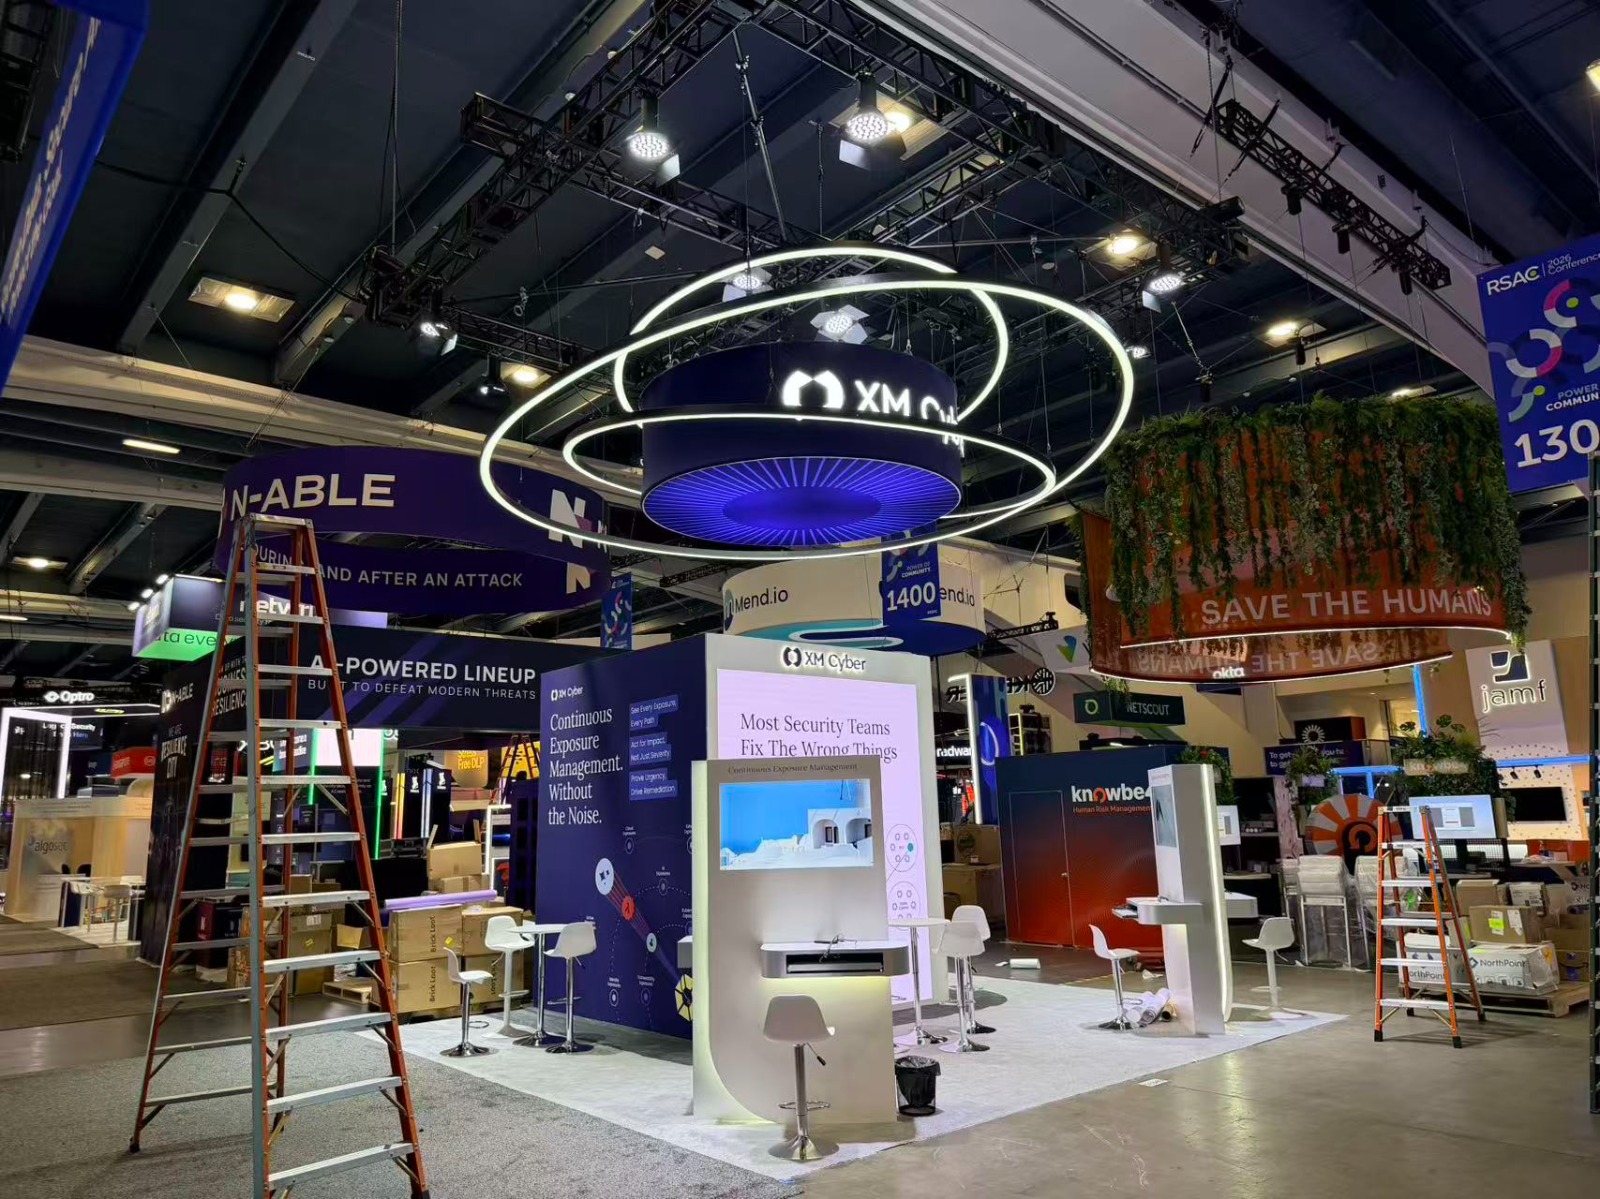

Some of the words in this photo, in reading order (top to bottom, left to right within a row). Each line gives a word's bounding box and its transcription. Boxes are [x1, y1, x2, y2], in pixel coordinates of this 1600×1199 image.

[1548, 254, 1571, 269] 2026
[1548, 252, 1600, 275] Conferenc
[1486, 266, 1540, 296] RSAC
[855, 380, 909, 417] XM
[1545, 392, 1600, 412] COMMUN
[1557, 383, 1599, 400] POWER
[1514, 419, 1600, 468] 130
[230, 474, 396, 521] N-ABLE
[319, 564, 352, 582] AND
[358, 571, 417, 586] AFTER
[424, 573, 449, 587] AN
[455, 573, 523, 588] ATTACK
[736, 586, 789, 613] Mend.io
[887, 582, 936, 612] 1400
[940, 586, 976, 607] end.io
[1201, 594, 1290, 625] SAVE
[1302, 591, 1371, 616] THE
[1383, 588, 1492, 616] HUMANS
[310, 655, 457, 682] A-POWERED
[464, 664, 536, 684] LINEUP
[804, 652, 824, 666] XM
[828, 654, 866, 671] Cyber
[1212, 667, 1245, 679] okta
[308, 679, 348, 692] BUT
[353, 681, 369, 693] TO
[375, 683, 424, 695] DEFEAT
[428, 685, 480, 698] MODERN
[484, 687, 536, 700] THREATS
[558, 688, 566, 698] XM
[567, 686, 584, 698] Cyber
[1482, 680, 1546, 713] jamf
[213, 690, 247, 716] ESILIENC
[631, 706, 639, 714] See
[640, 704, 652, 713] Every
[1126, 701, 1170, 716] NETSCOUT
[550, 708, 612, 731] Continuous
[631, 719, 643, 728] Every
[741, 713, 780, 731] Most
[784, 715, 844, 738] Security
[848, 718, 890, 736] Teams
[550, 734, 600, 758] Exposure
[741, 739, 764, 756] Fix
[768, 740, 798, 757] The
[801, 742, 850, 756] Wrong
[853, 742, 898, 764] Things
[936, 746, 972, 758] radwar
[458, 759, 471, 770] Free
[472, 758, 484, 768] DLP
[550, 754, 623, 781] Management.
[631, 753, 640, 762] Not
[640, 752, 650, 760] Just
[631, 774, 644, 782] Prove
[728, 766, 770, 774] Continuous
[773, 765, 807, 774] Exposure
[810, 764, 858, 772] Management
[549, 782, 592, 801] Without
[631, 788, 643, 796] Drive
[548, 806, 565, 824] the
[568, 806, 602, 824] Noise.
[1409, 970, 1445, 980] orthPoin
